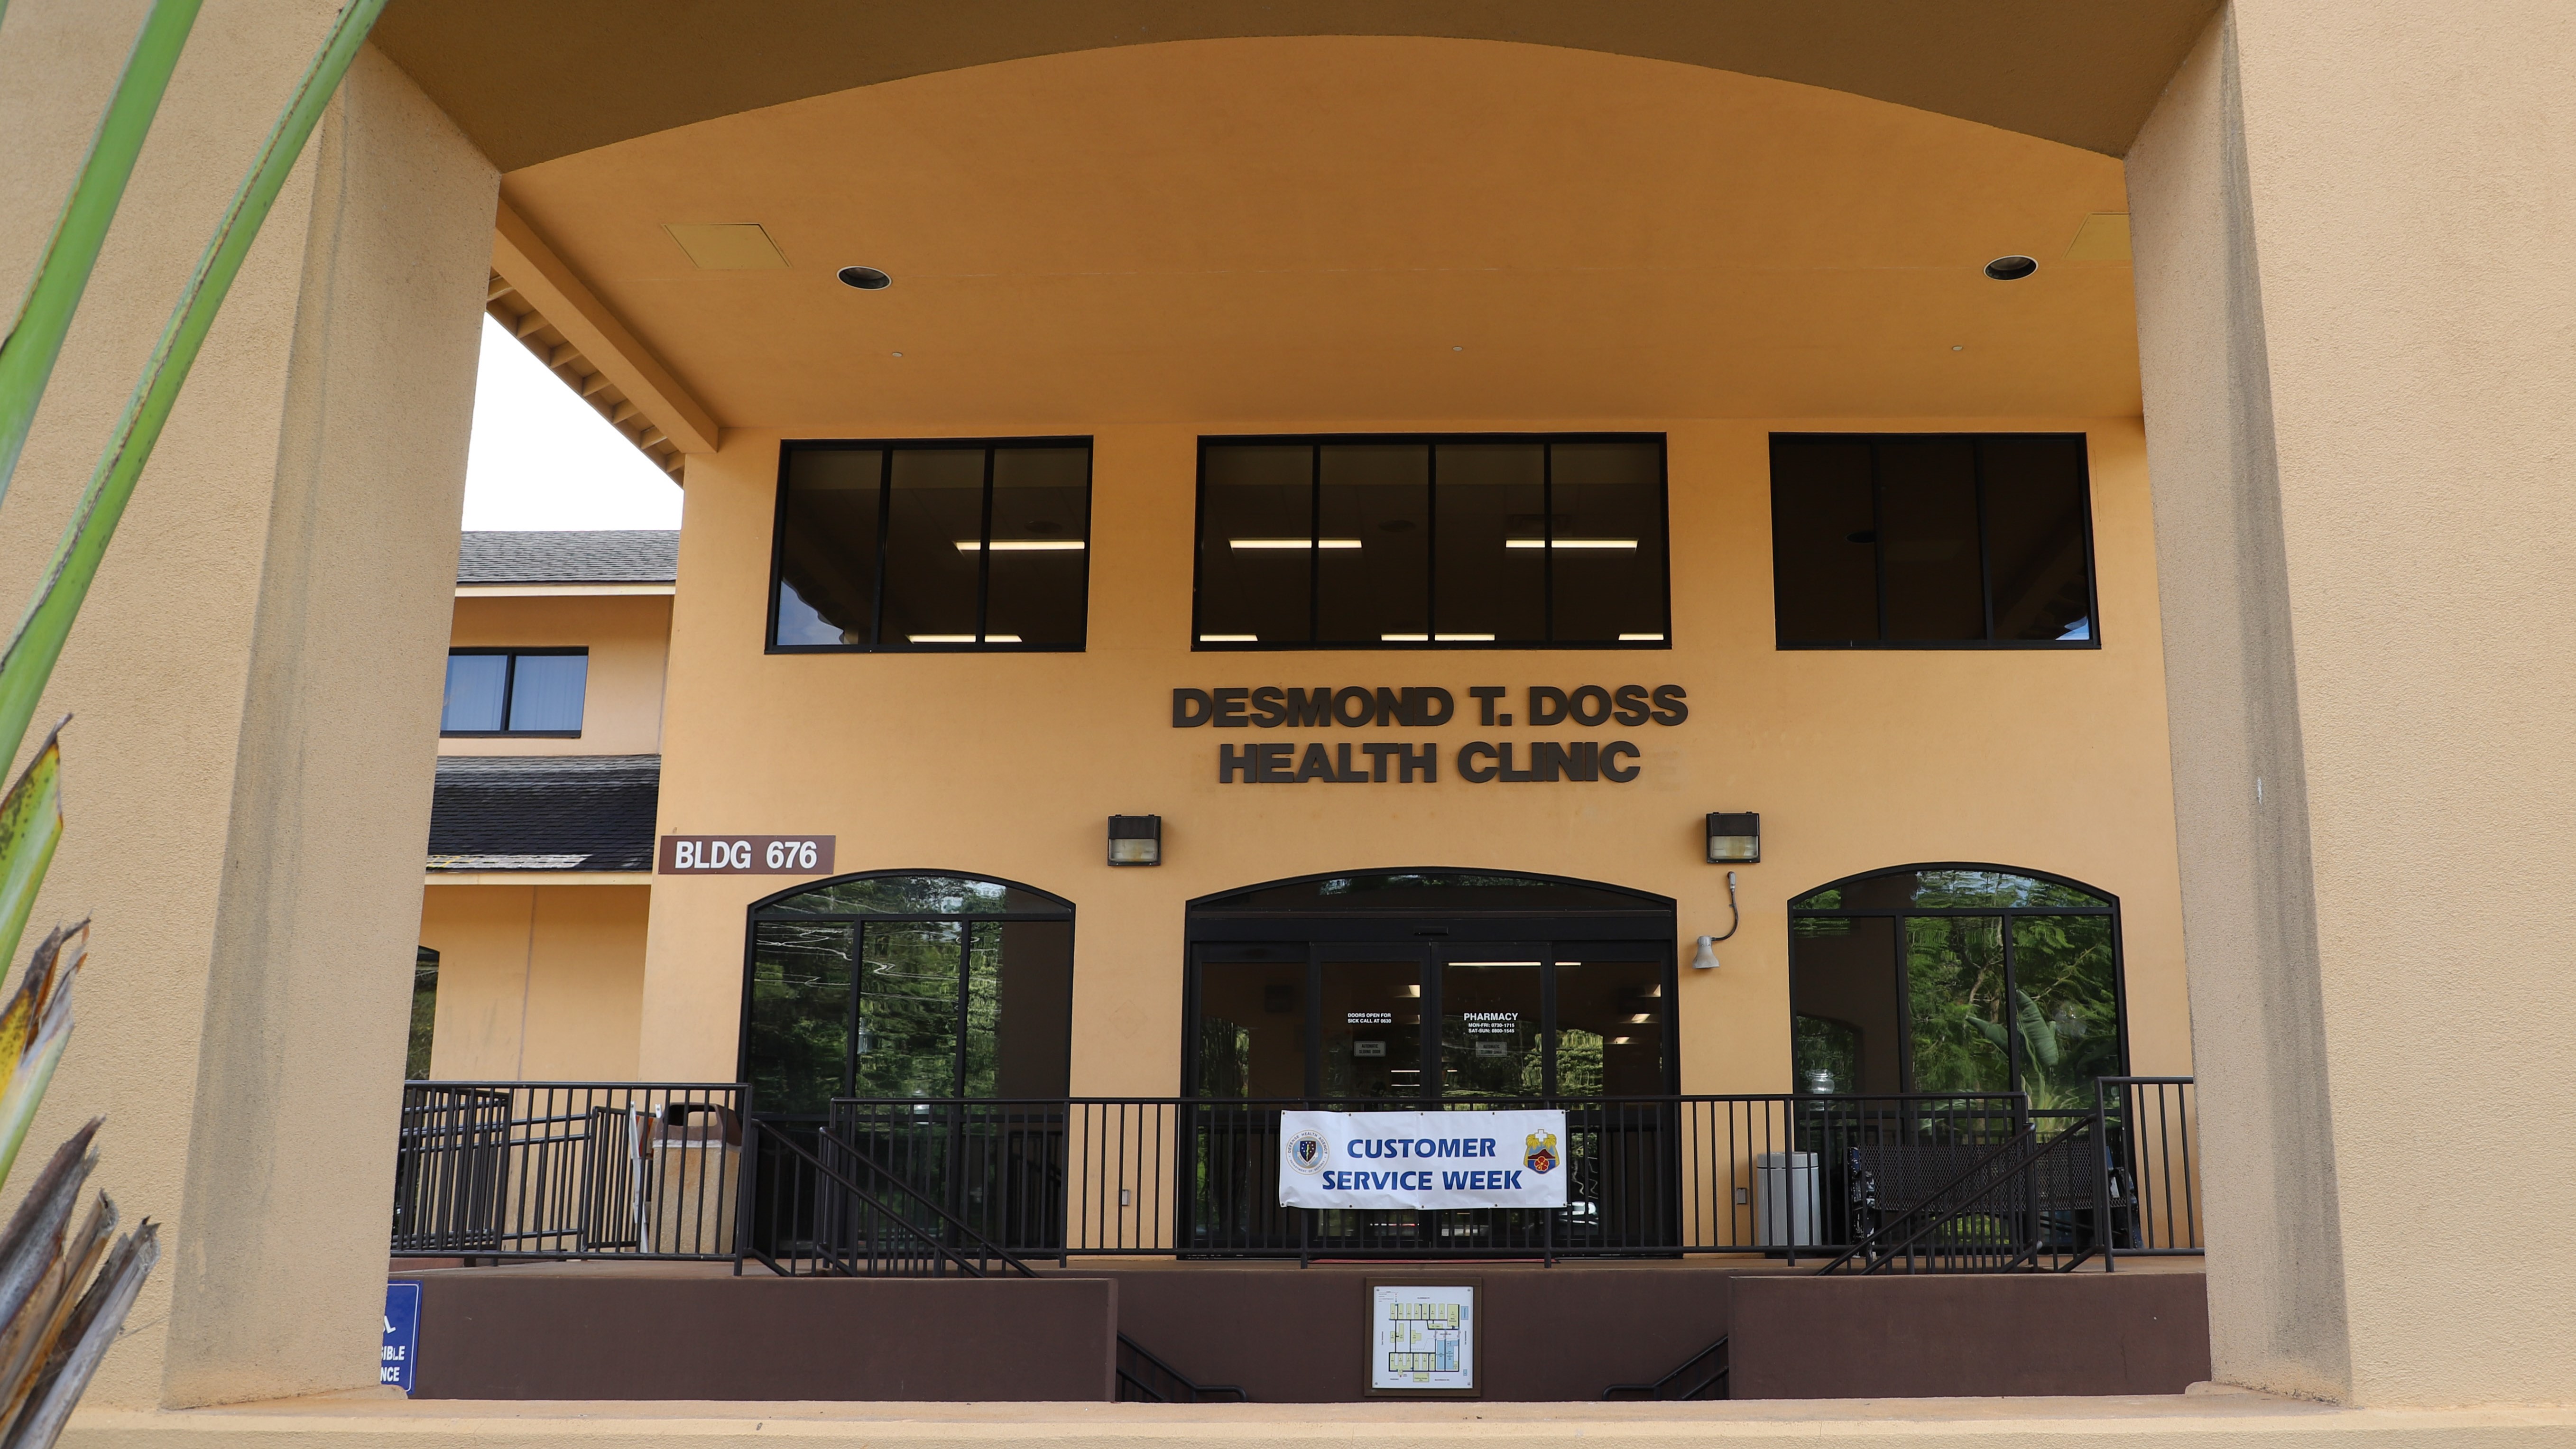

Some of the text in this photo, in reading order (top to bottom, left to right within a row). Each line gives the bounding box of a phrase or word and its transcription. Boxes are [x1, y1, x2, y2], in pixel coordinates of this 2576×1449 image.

[1172, 684, 1689, 728] DESMOND T. DOSS
[1219, 740, 1641, 783] HEALTH CLINIC
[675, 840, 817, 869] BLDG 676
[1464, 1013, 1518, 1021] PHARMACY
[1287, 1135, 1300, 1154] DEFENSE
[1318, 1137, 1328, 1154] AGENCY
[1347, 1138, 1496, 1158] CUSTOMER
[1322, 1170, 1523, 1191] SERVICE WEEK
